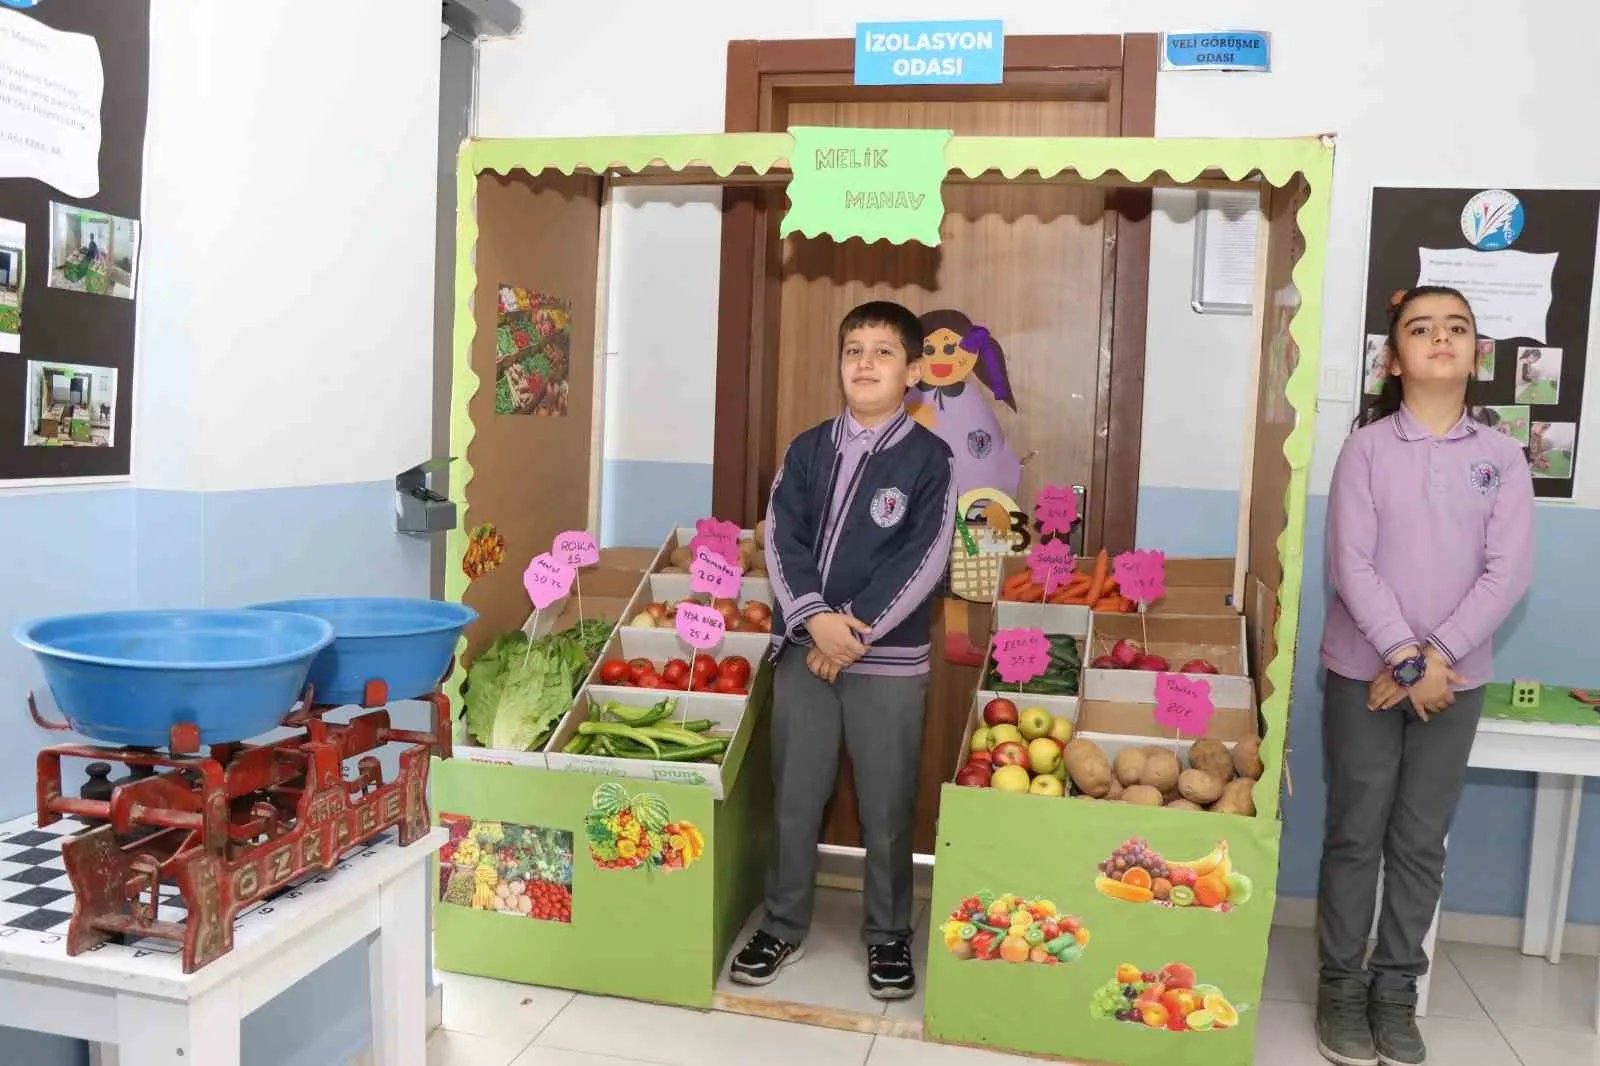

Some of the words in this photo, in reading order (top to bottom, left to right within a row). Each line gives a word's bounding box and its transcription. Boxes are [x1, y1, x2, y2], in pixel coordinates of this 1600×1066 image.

[865, 30, 993, 52] İZOLASYON
[1171, 37, 1197, 49] VELİ
[1200, 35, 1260, 51] GÖRÜŞME
[893, 57, 963, 77] ODASI
[1196, 53, 1235, 63] ODASI
[845, 190, 926, 210] MANAV
